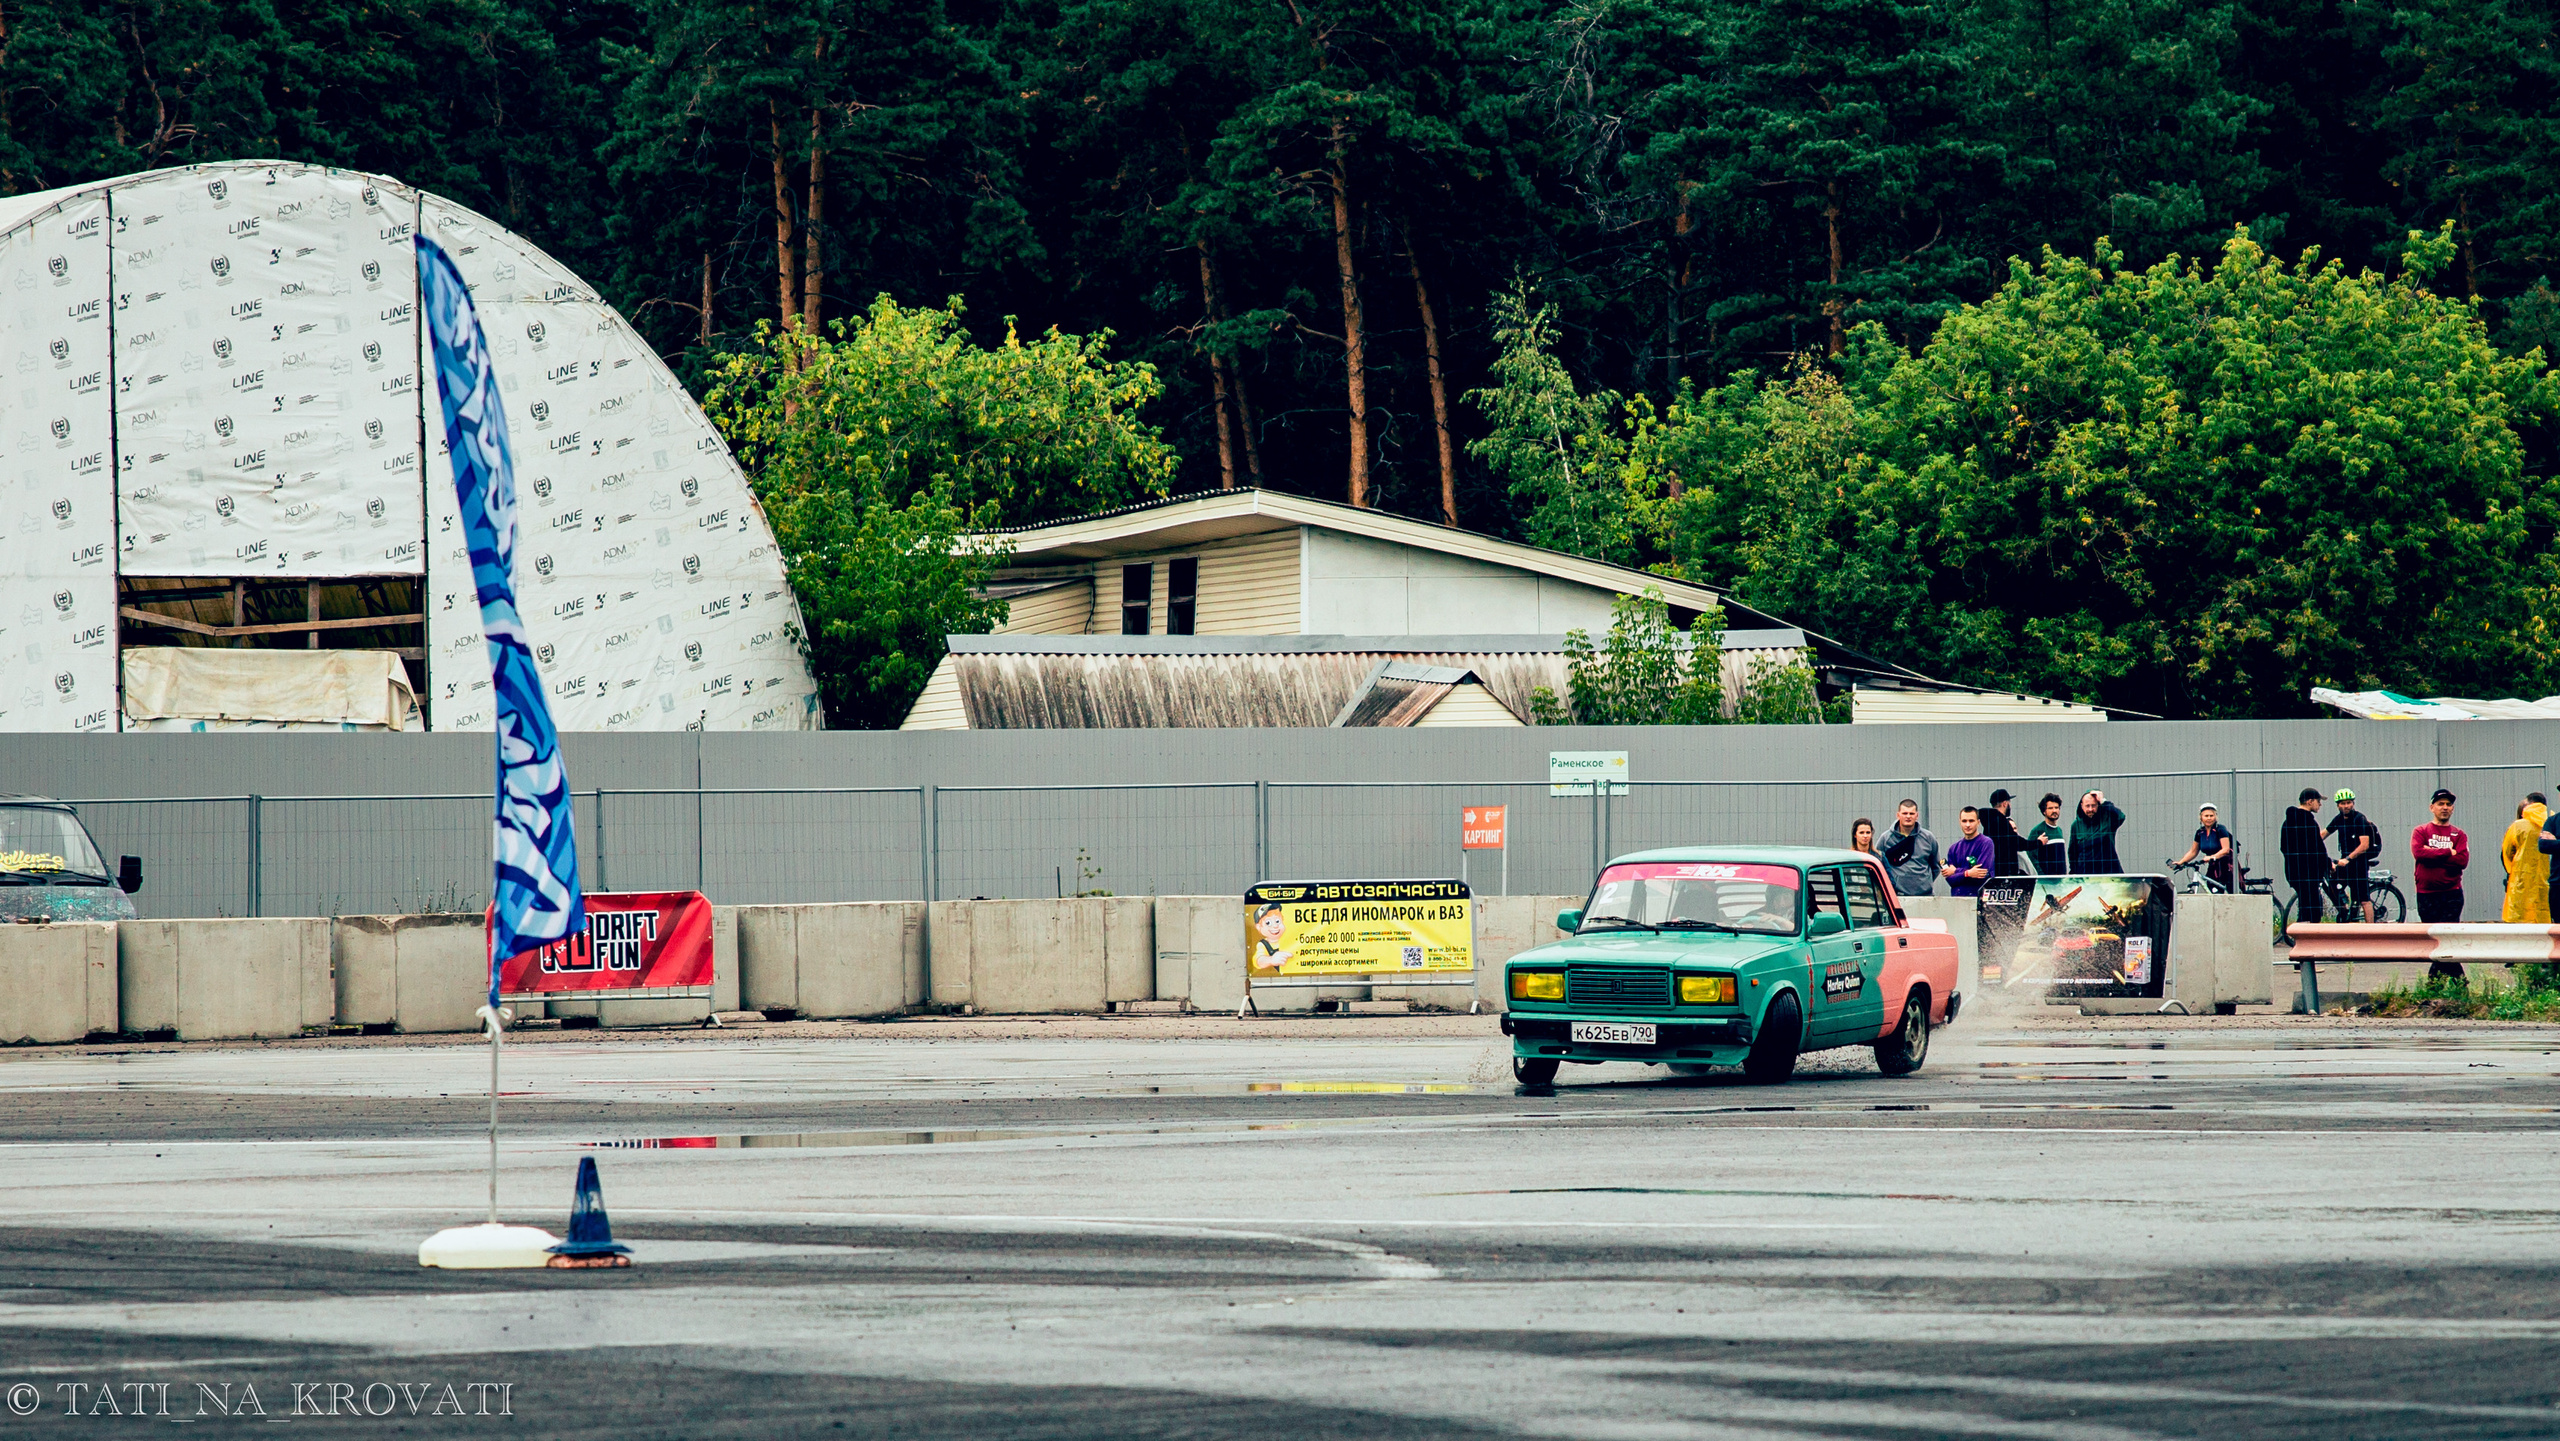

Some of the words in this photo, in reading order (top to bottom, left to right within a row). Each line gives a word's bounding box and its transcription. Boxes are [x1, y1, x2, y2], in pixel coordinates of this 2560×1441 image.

[277, 201, 302, 216] ADM
[128, 249, 153, 265] ADM
[280, 281, 305, 297] ADM
[130, 332, 155, 348] ADM
[282, 352, 307, 368] ADM
[600, 396, 625, 412] ADM
[132, 410, 157, 426] ADM
[284, 430, 309, 446] ADM
[602, 472, 627, 488] ADM
[133, 485, 158, 501] ADM
[285, 503, 310, 519] ADM
[603, 543, 628, 559] ADM
[455, 634, 480, 650] ADM
[605, 633, 630, 649] ADM
[750, 630, 775, 646] ADM
[456, 712, 481, 728] ADM
[607, 711, 632, 727] ADM
[752, 708, 777, 724] ADM
[1551, 757, 1604, 768] Раменское
[1464, 829, 1502, 844] КАРТИНГ
[1316, 884, 1459, 899] АВТОЗАПЧАСТИ
[1601, 882, 1618, 904] 2
[1988, 889, 2023, 902] ROLF
[1294, 908, 1318, 923] ВСЕ
[1321, 907, 1348, 925] ДЛЯ
[1352, 906, 1425, 921] ИНОМАРОК
[1428, 909, 1436, 920] и
[1440, 905, 1464, 920] ВАЗ
[594, 910, 659, 941] DRIFT
[1299, 933, 1326, 944] более
[1328, 932, 1338, 942] 20
[1340, 932, 1355, 942] 000
[595, 940, 641, 971] FUN
[1300, 948, 1339, 956] доступные
[1300, 958, 1332, 967] широкий
[1334, 958, 1378, 967] ассортимент
[1827, 977, 1844, 993] Harley
[1845, 974, 1860, 989] Quinn
[1631, 1026, 1652, 1038] 790
